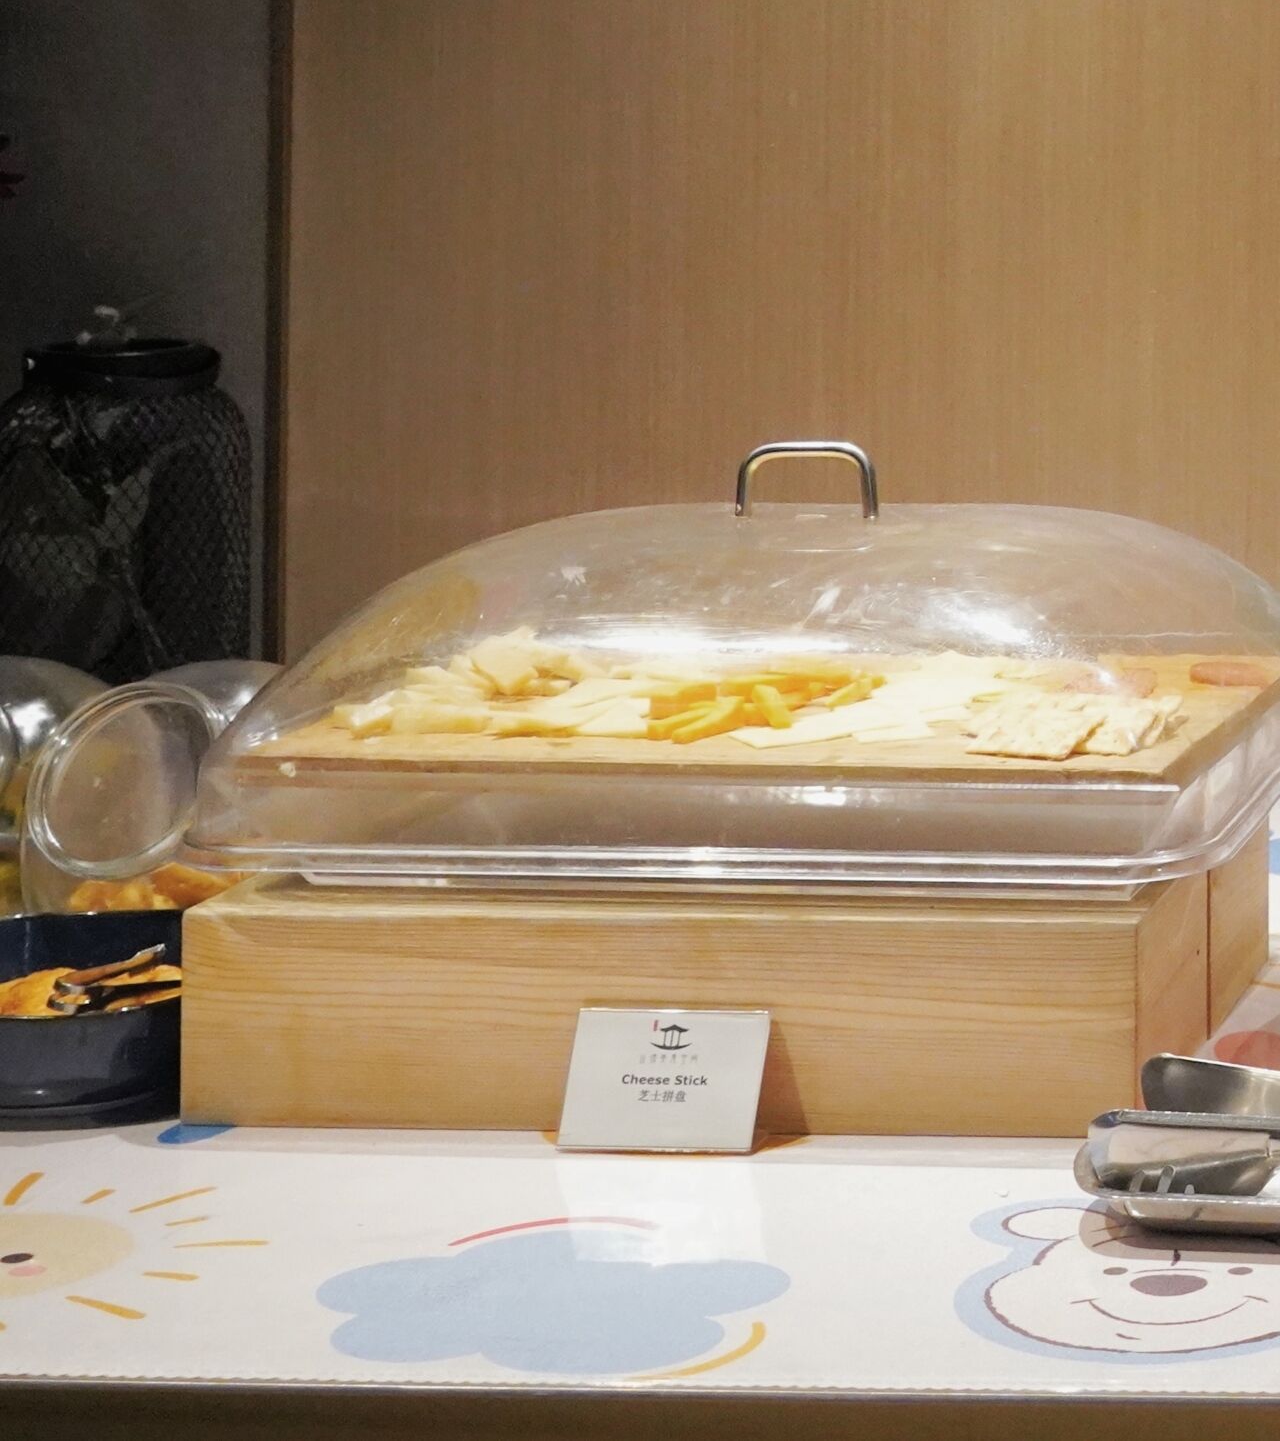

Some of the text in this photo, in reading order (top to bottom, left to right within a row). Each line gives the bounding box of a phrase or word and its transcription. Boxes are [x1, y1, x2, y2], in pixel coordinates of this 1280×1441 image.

[621, 1073, 709, 1087] Cheese Stick
[637, 1088, 688, 1103] 芝士拼盘
